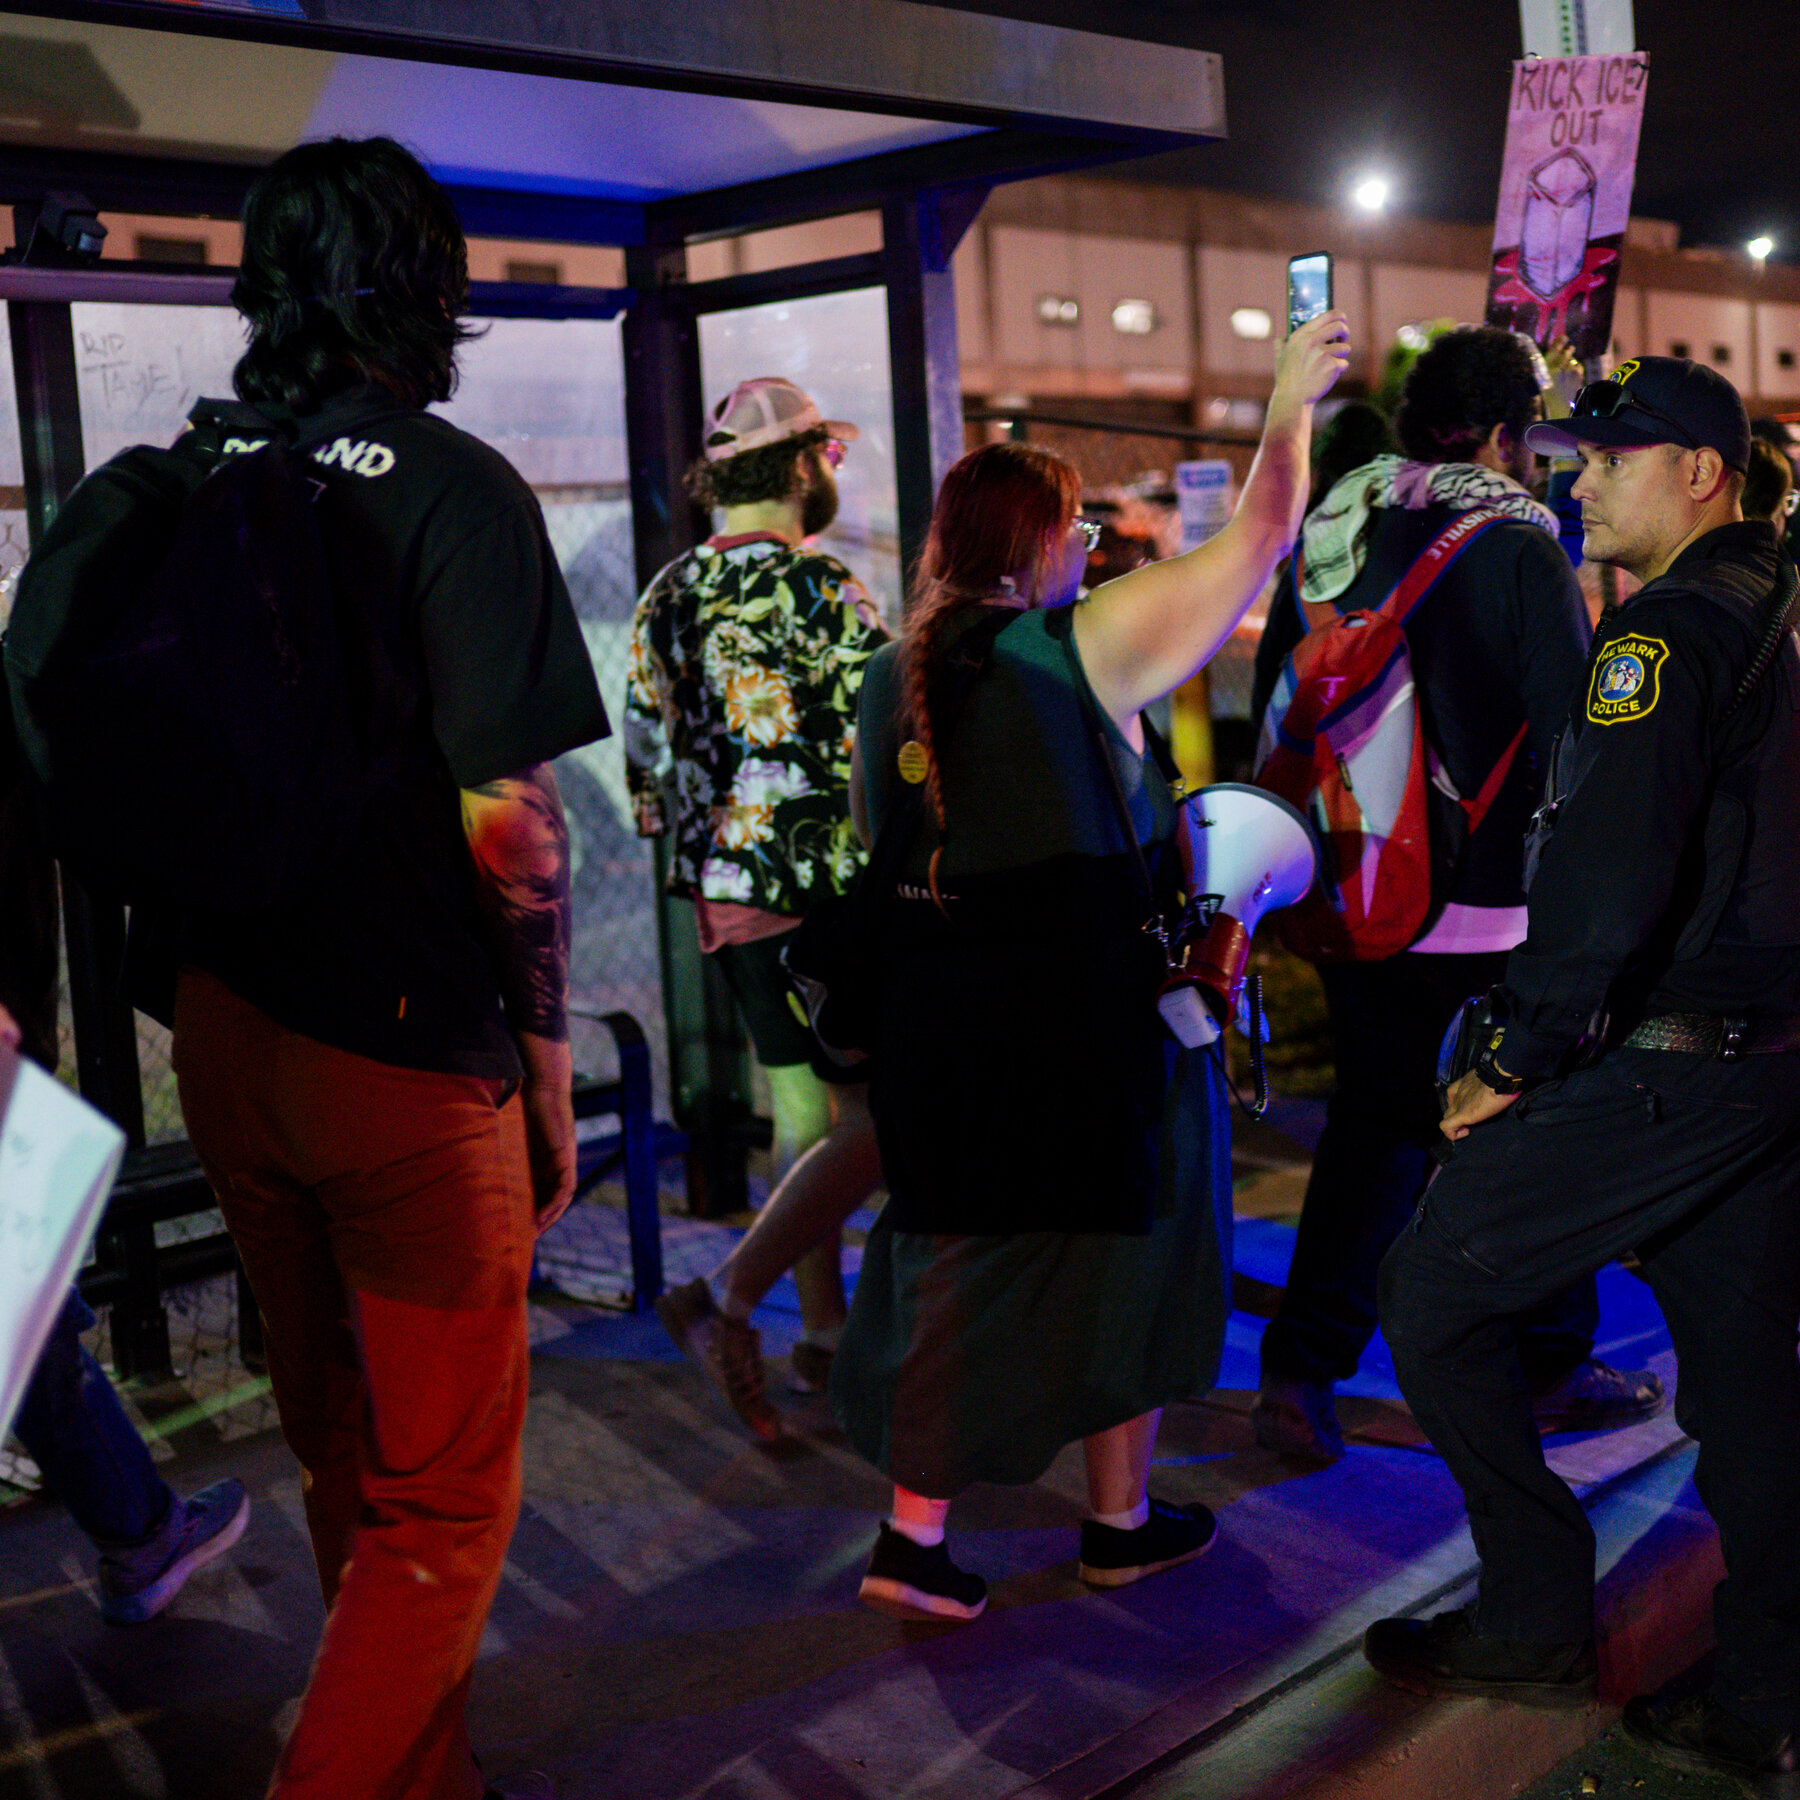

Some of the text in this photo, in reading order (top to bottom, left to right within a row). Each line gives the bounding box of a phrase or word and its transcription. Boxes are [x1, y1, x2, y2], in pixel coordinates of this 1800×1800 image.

[1517, 60, 1585, 111] KICK
[1550, 109, 1603, 147] OUT
[1601, 642, 1659, 662] NEWARK
[1592, 700, 1640, 715] POLICE
